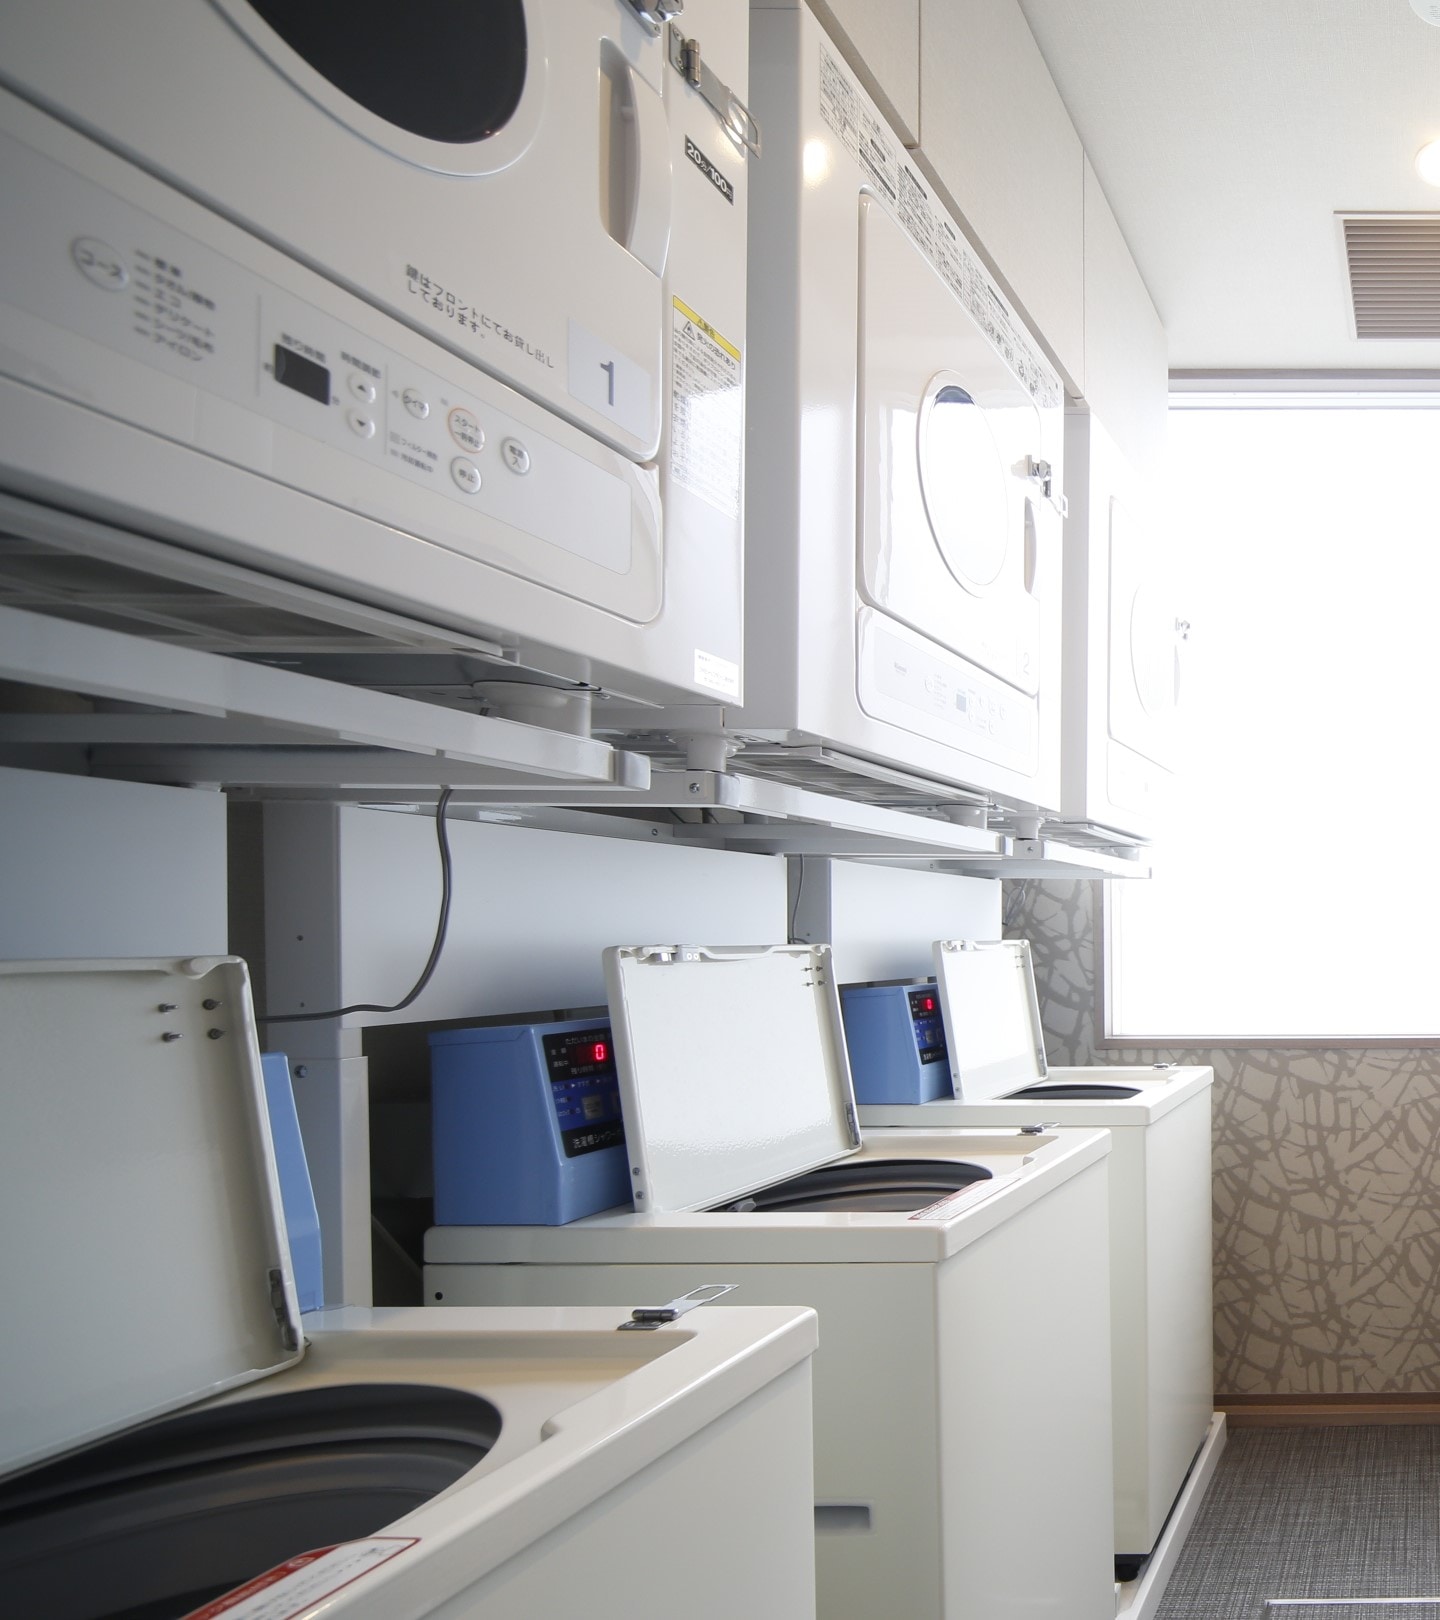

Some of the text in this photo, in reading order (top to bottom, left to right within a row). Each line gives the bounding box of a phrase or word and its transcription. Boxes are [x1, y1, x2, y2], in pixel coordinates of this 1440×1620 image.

[81, 249, 123, 282] コース
[406, 264, 554, 369] 鍵はフロントにてお貸し出し
[408, 279, 486, 340] しております。
[600, 360, 614, 407] 1
[926, 998, 935, 1010] 0
[595, 1044, 605, 1060] 0
